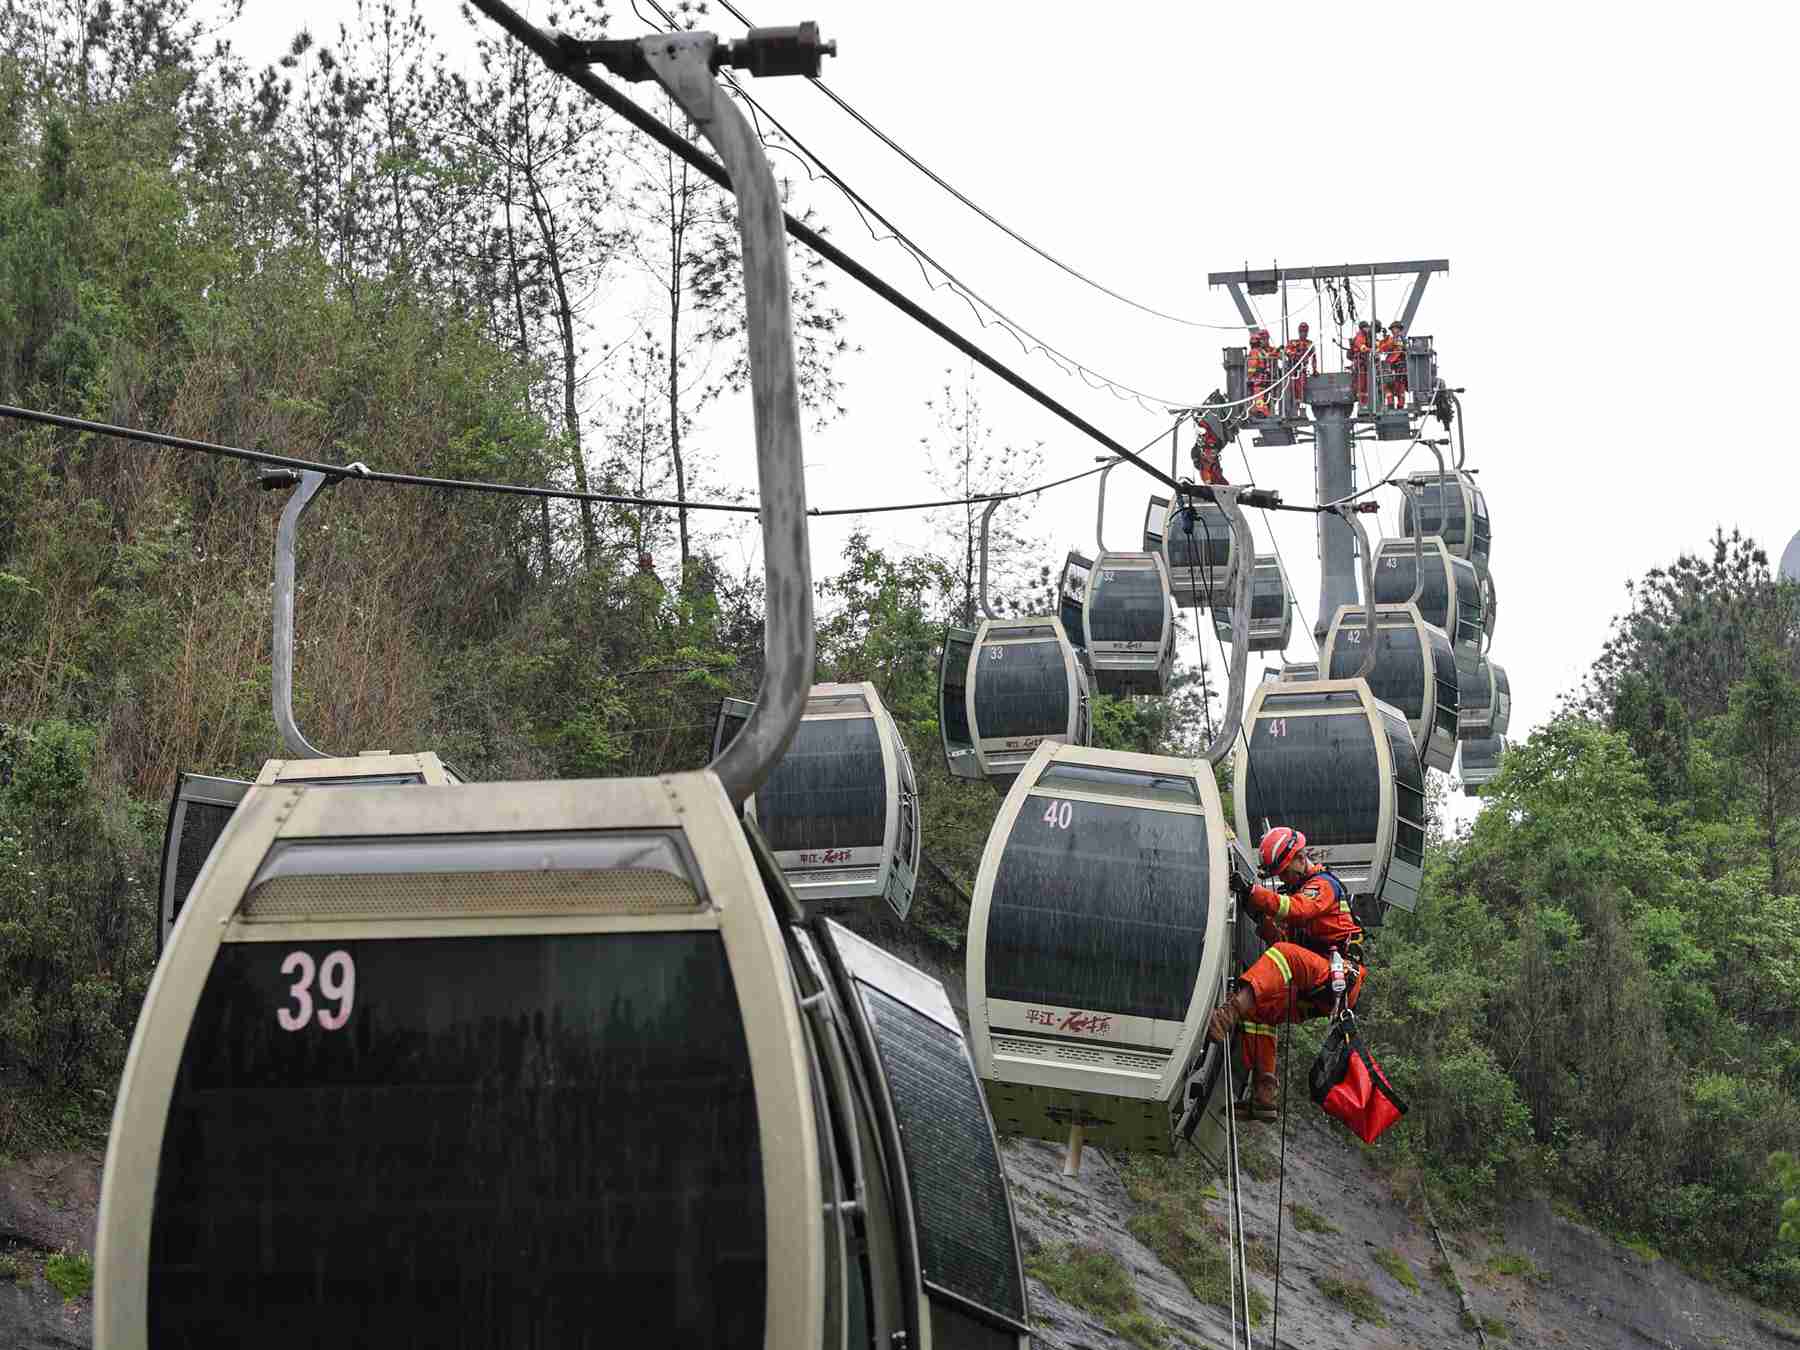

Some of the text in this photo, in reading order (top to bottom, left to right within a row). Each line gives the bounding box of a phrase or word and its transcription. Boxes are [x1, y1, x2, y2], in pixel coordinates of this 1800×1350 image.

[1386, 558, 1398, 569] 43
[1348, 630, 1361, 643] 42
[991, 646, 1003, 660] 33
[1269, 718, 1286, 737] 41
[1043, 800, 1072, 829] 40
[277, 950, 356, 1031] 39
